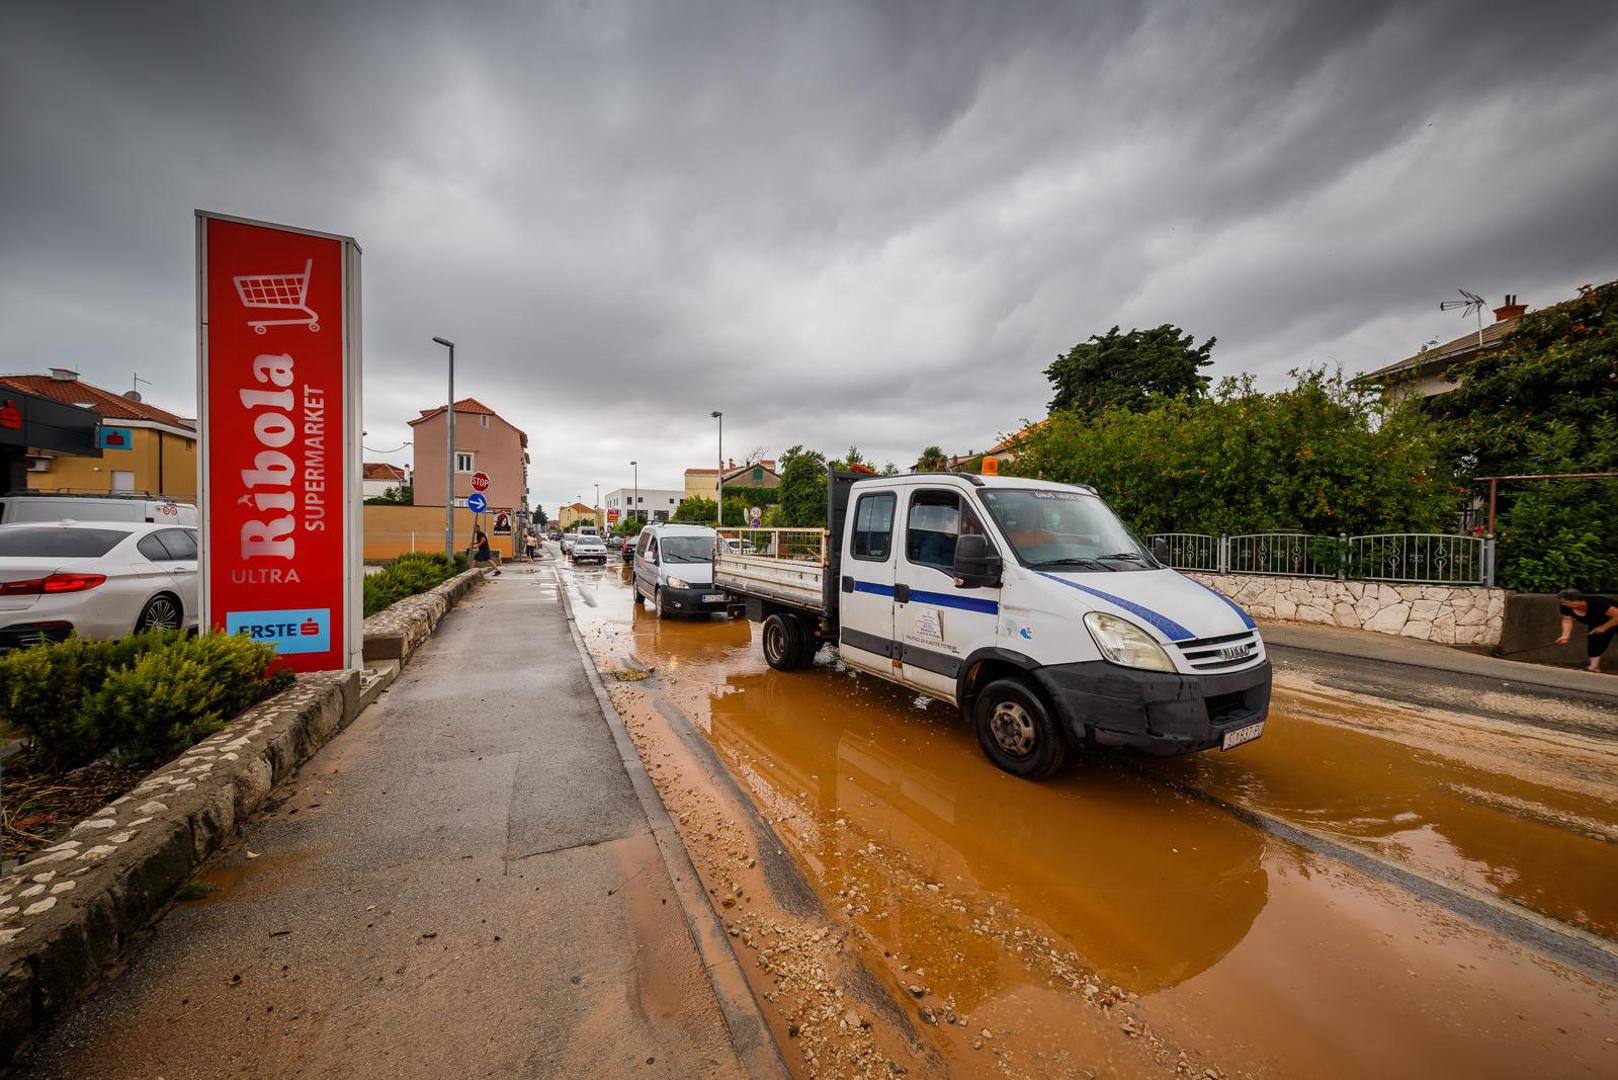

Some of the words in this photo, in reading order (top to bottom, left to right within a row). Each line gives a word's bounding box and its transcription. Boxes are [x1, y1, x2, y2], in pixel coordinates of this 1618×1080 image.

[239, 353, 296, 561] Ribola
[303, 384, 326, 532] SUPERMARKET
[472, 478, 488, 486] STOP
[231, 568, 301, 586] ULTRA
[238, 623, 297, 638] ERSTE
